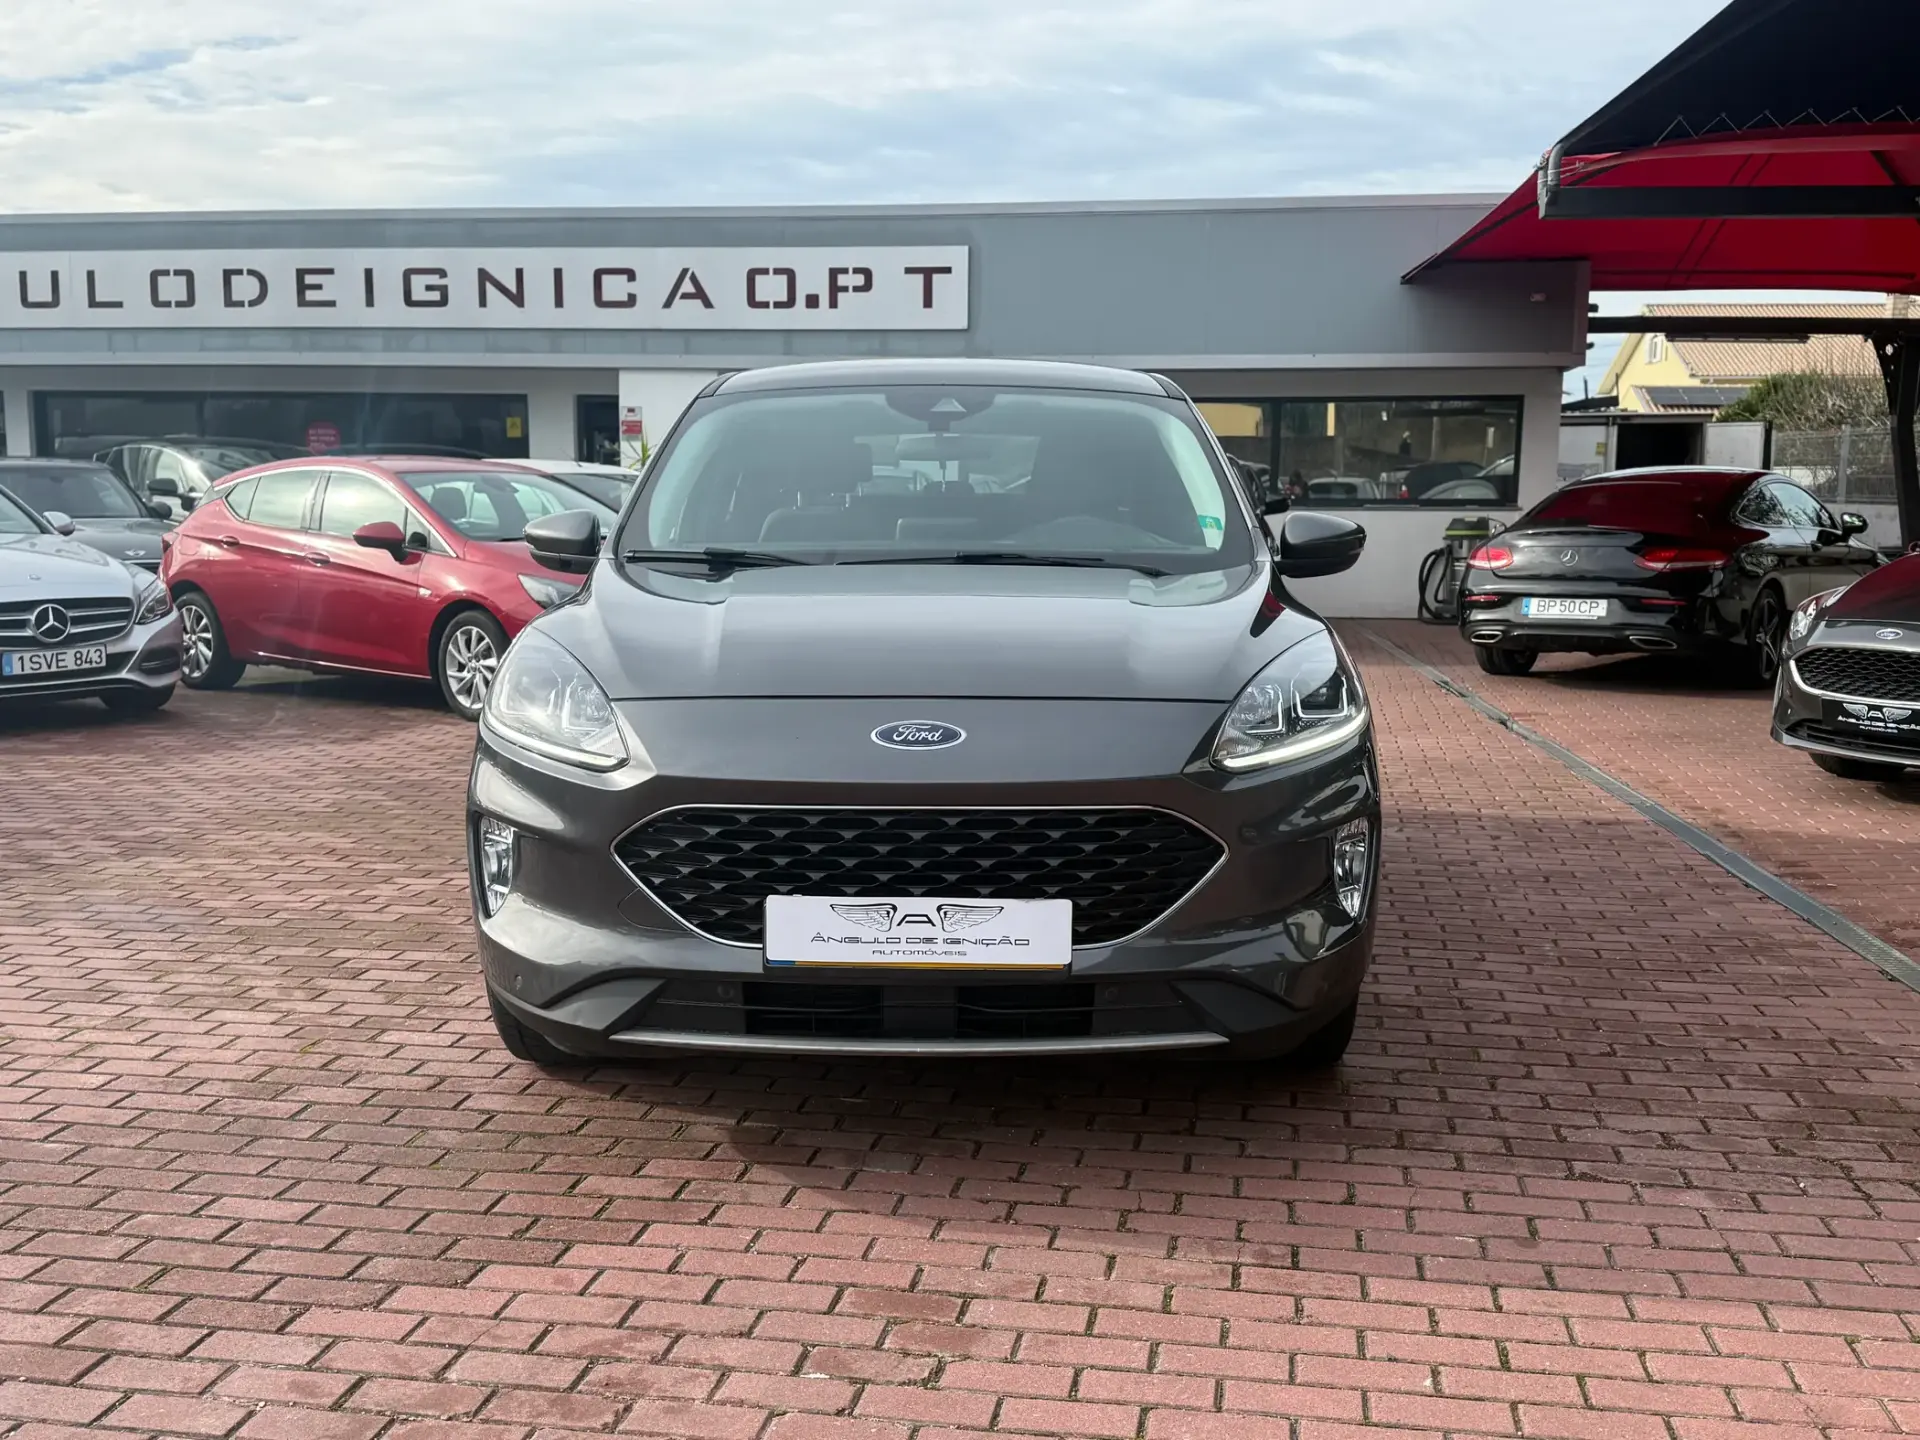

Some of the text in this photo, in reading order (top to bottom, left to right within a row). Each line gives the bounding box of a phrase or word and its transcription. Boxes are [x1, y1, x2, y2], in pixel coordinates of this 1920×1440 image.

[73, 648, 103, 667] 843
[892, 724, 944, 741] Ford
[810, 932, 1031, 948] ÂNGULO DE IGNIÇÃO
[872, 948, 968, 957] AUTOMÓVEIS
